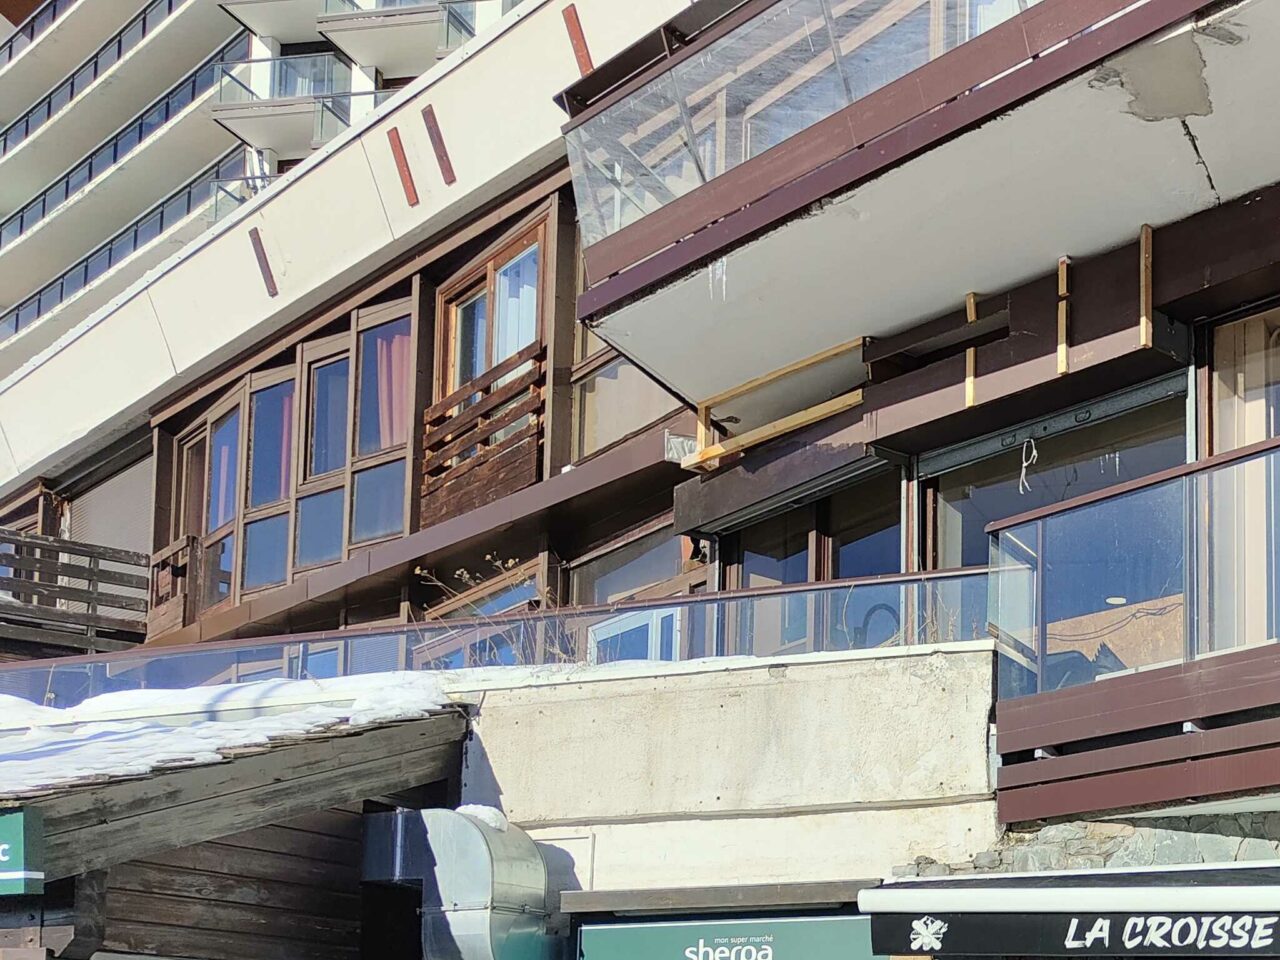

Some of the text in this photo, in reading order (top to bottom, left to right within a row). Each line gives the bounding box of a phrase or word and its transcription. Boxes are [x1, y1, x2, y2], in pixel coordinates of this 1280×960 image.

[731, 937, 748, 945] super
[749, 935, 773, 943] marché
[1065, 916, 1278, 950] LA CROISSE
